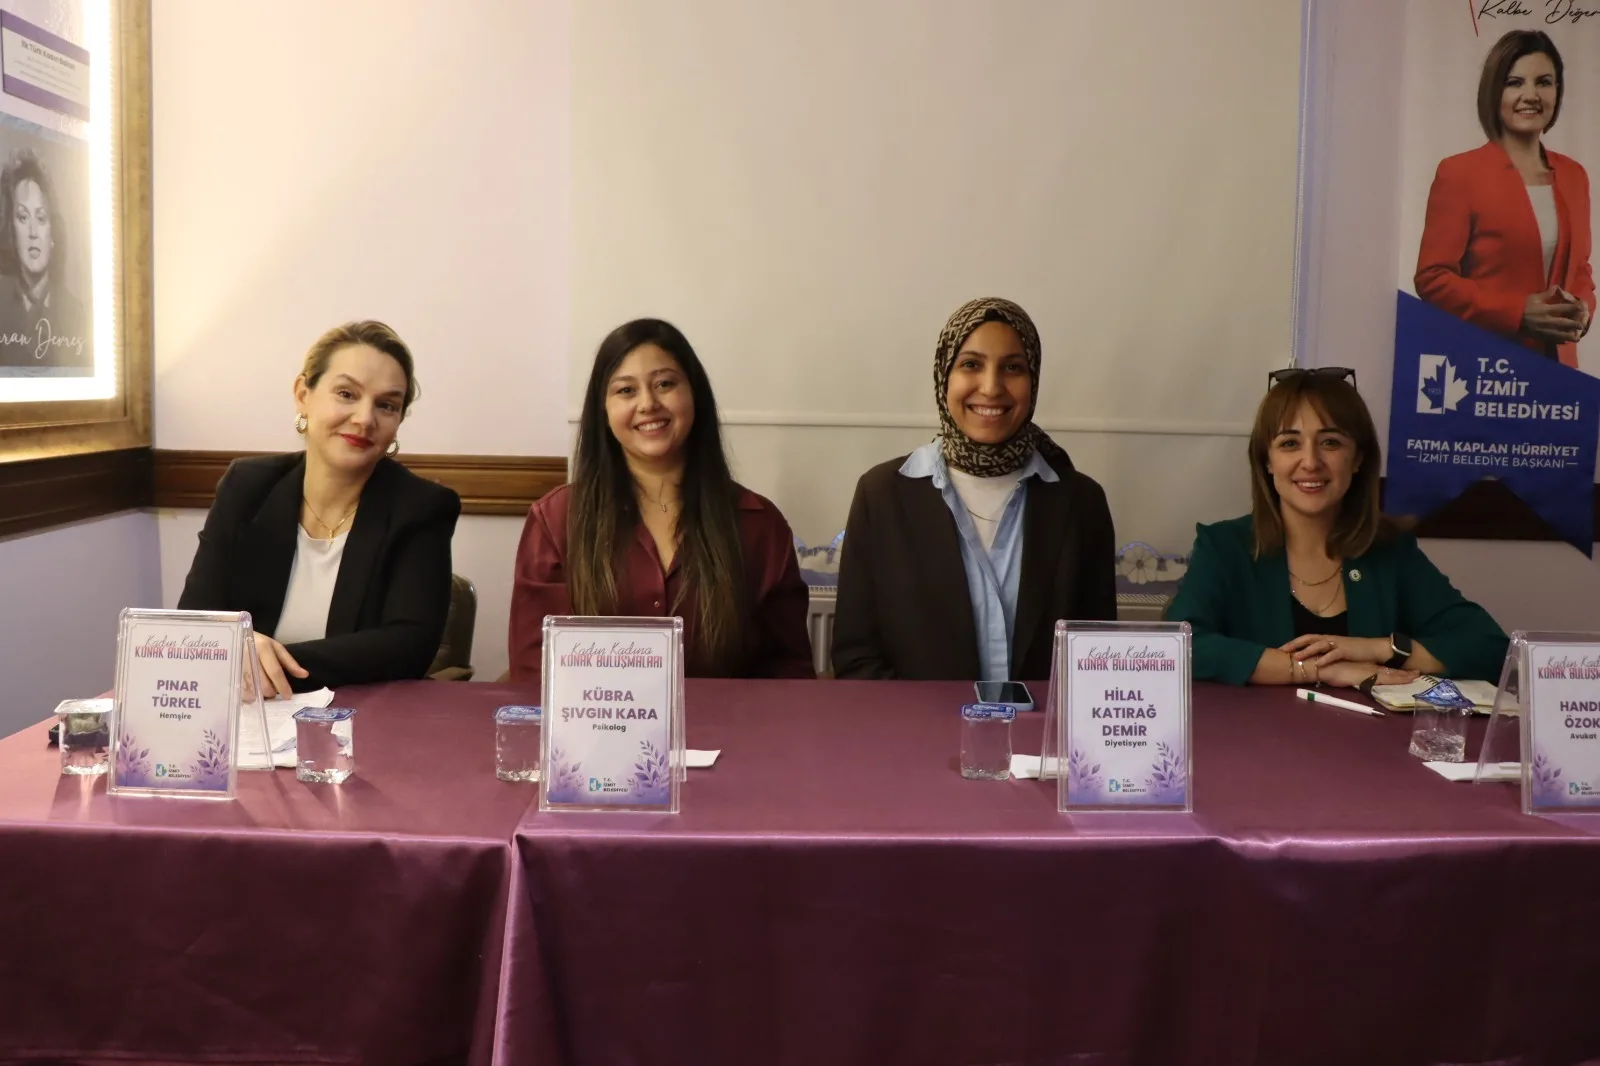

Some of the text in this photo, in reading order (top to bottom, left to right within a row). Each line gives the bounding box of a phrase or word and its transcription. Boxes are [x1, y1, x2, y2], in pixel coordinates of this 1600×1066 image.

[1478, 0, 1532, 19] Kalbe
[0, 332, 31, 345] ran
[1477, 357, 1514, 373] T.C.
[1475, 375, 1529, 396] İZMİT
[1474, 400, 1580, 420] BELEDİYESİ
[1407, 439, 1579, 457] FATMA KAPLAN HÜRRİYET
[1419, 453, 1564, 469] İZMİT BELEDİYE BAŞKANI
[144, 635, 219, 648] Kadın Kadına
[571, 641, 653, 655] Kadın Kadına
[1088, 646, 1166, 659] Kadın Kadına
[157, 680, 198, 692] PINAR
[583, 687, 634, 701] KÜBRA
[1104, 687, 1144, 701] HİLAL
[152, 694, 201, 709] TÜRKEL
[160, 712, 191, 721] Hemşire
[561, 707, 658, 722] ŞIVGIN KARA
[1092, 704, 1157, 719] KATIRAĞ
[592, 723, 626, 732] Psikolog
[1564, 715, 1600, 728] ÖZOK
[1102, 722, 1147, 736] DEMİR
[1104, 739, 1147, 748] Diyetisyen
